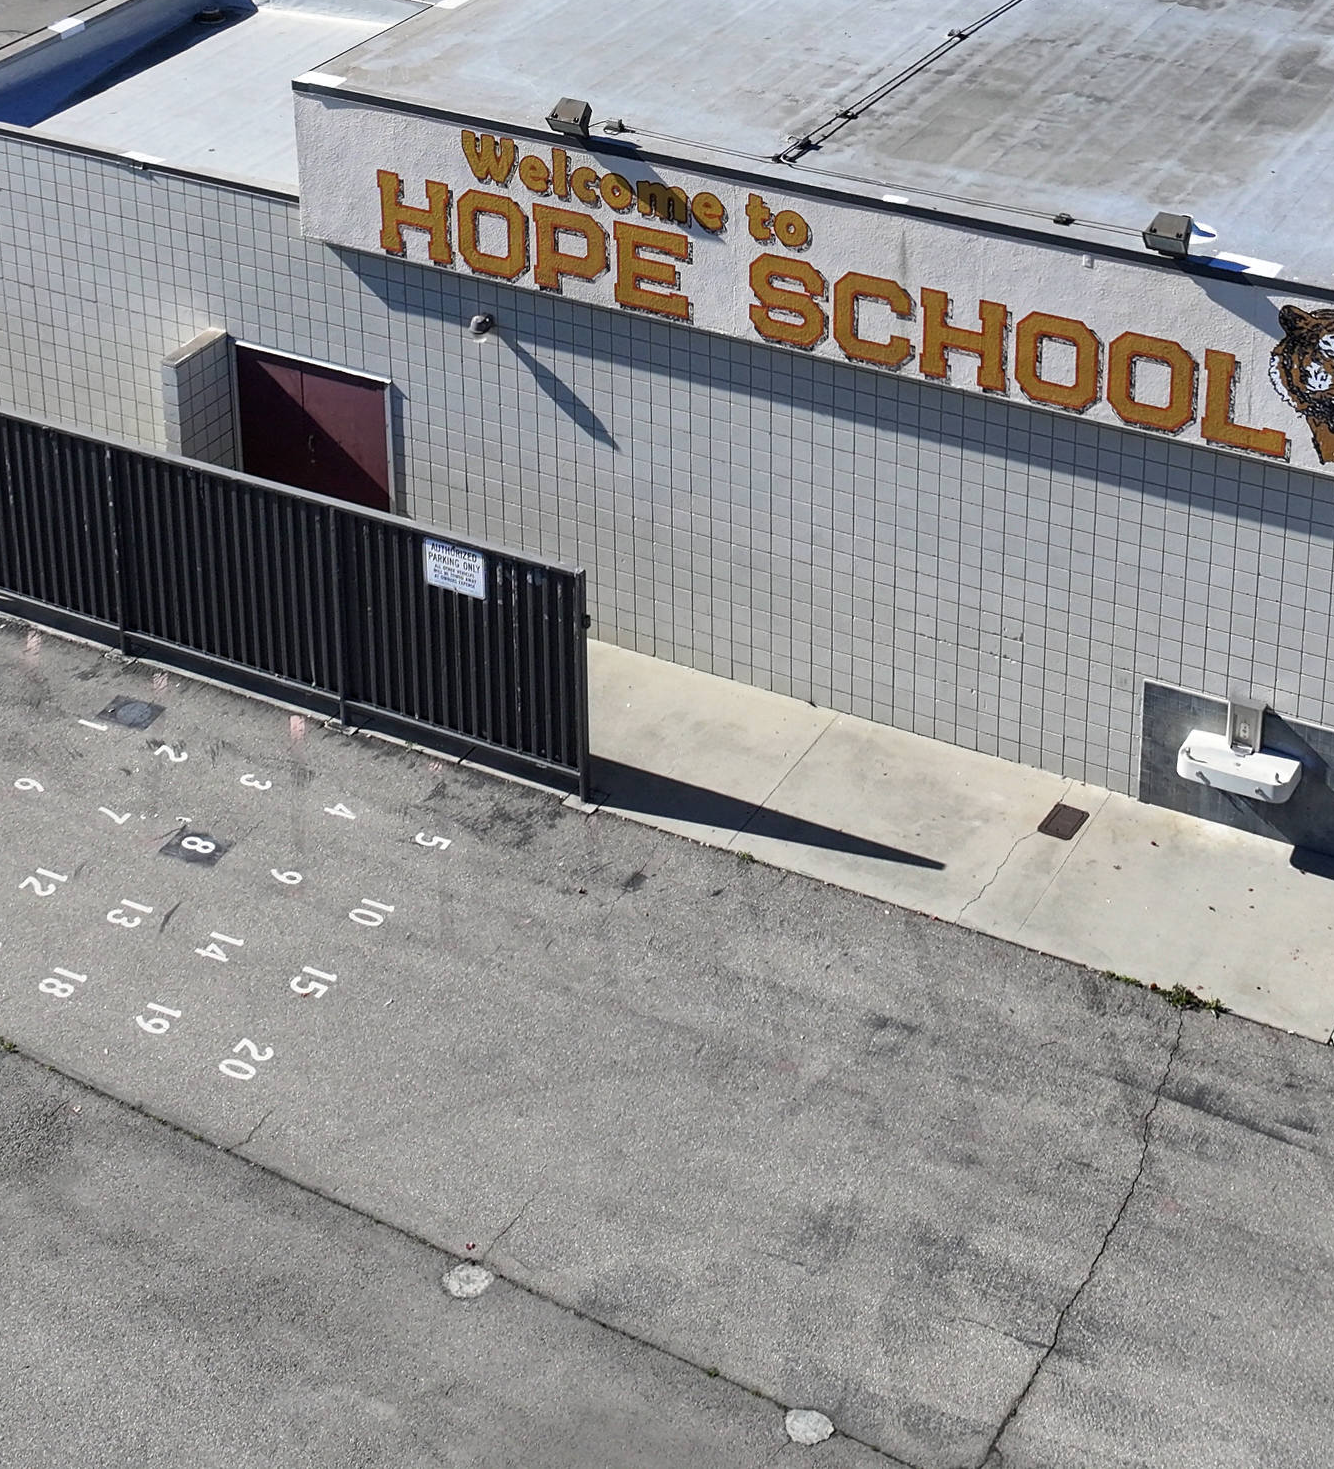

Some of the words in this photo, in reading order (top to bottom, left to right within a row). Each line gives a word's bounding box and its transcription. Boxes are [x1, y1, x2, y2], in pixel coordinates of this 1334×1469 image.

[461, 129, 728, 232] Welcome
[745, 193, 813, 252] to
[377, 168, 693, 324] HOPE
[748, 252, 1290, 461] SCHOOL
[428, 551, 460, 568] PARKING
[463, 561, 480, 574] ONLY
[431, 542, 477, 563] AUTHORIZED
[78, 719, 107, 731] 1
[154, 745, 187, 762] 2
[14, 778, 43, 792] 6
[240, 774, 271, 790] 3
[98, 807, 130, 824] 7
[324, 803, 356, 820] 4
[182, 837, 214, 853] 8
[415, 832, 450, 849] 5
[19, 868, 67, 896] 12
[271, 869, 301, 884] 9
[107, 899, 152, 928] 13
[349, 898, 393, 926] 10
[195, 931, 243, 962] 14
[38, 967, 86, 998] 18
[290, 966, 336, 998] 15
[136, 1002, 180, 1034] 19
[219, 1038, 273, 1080] 20
